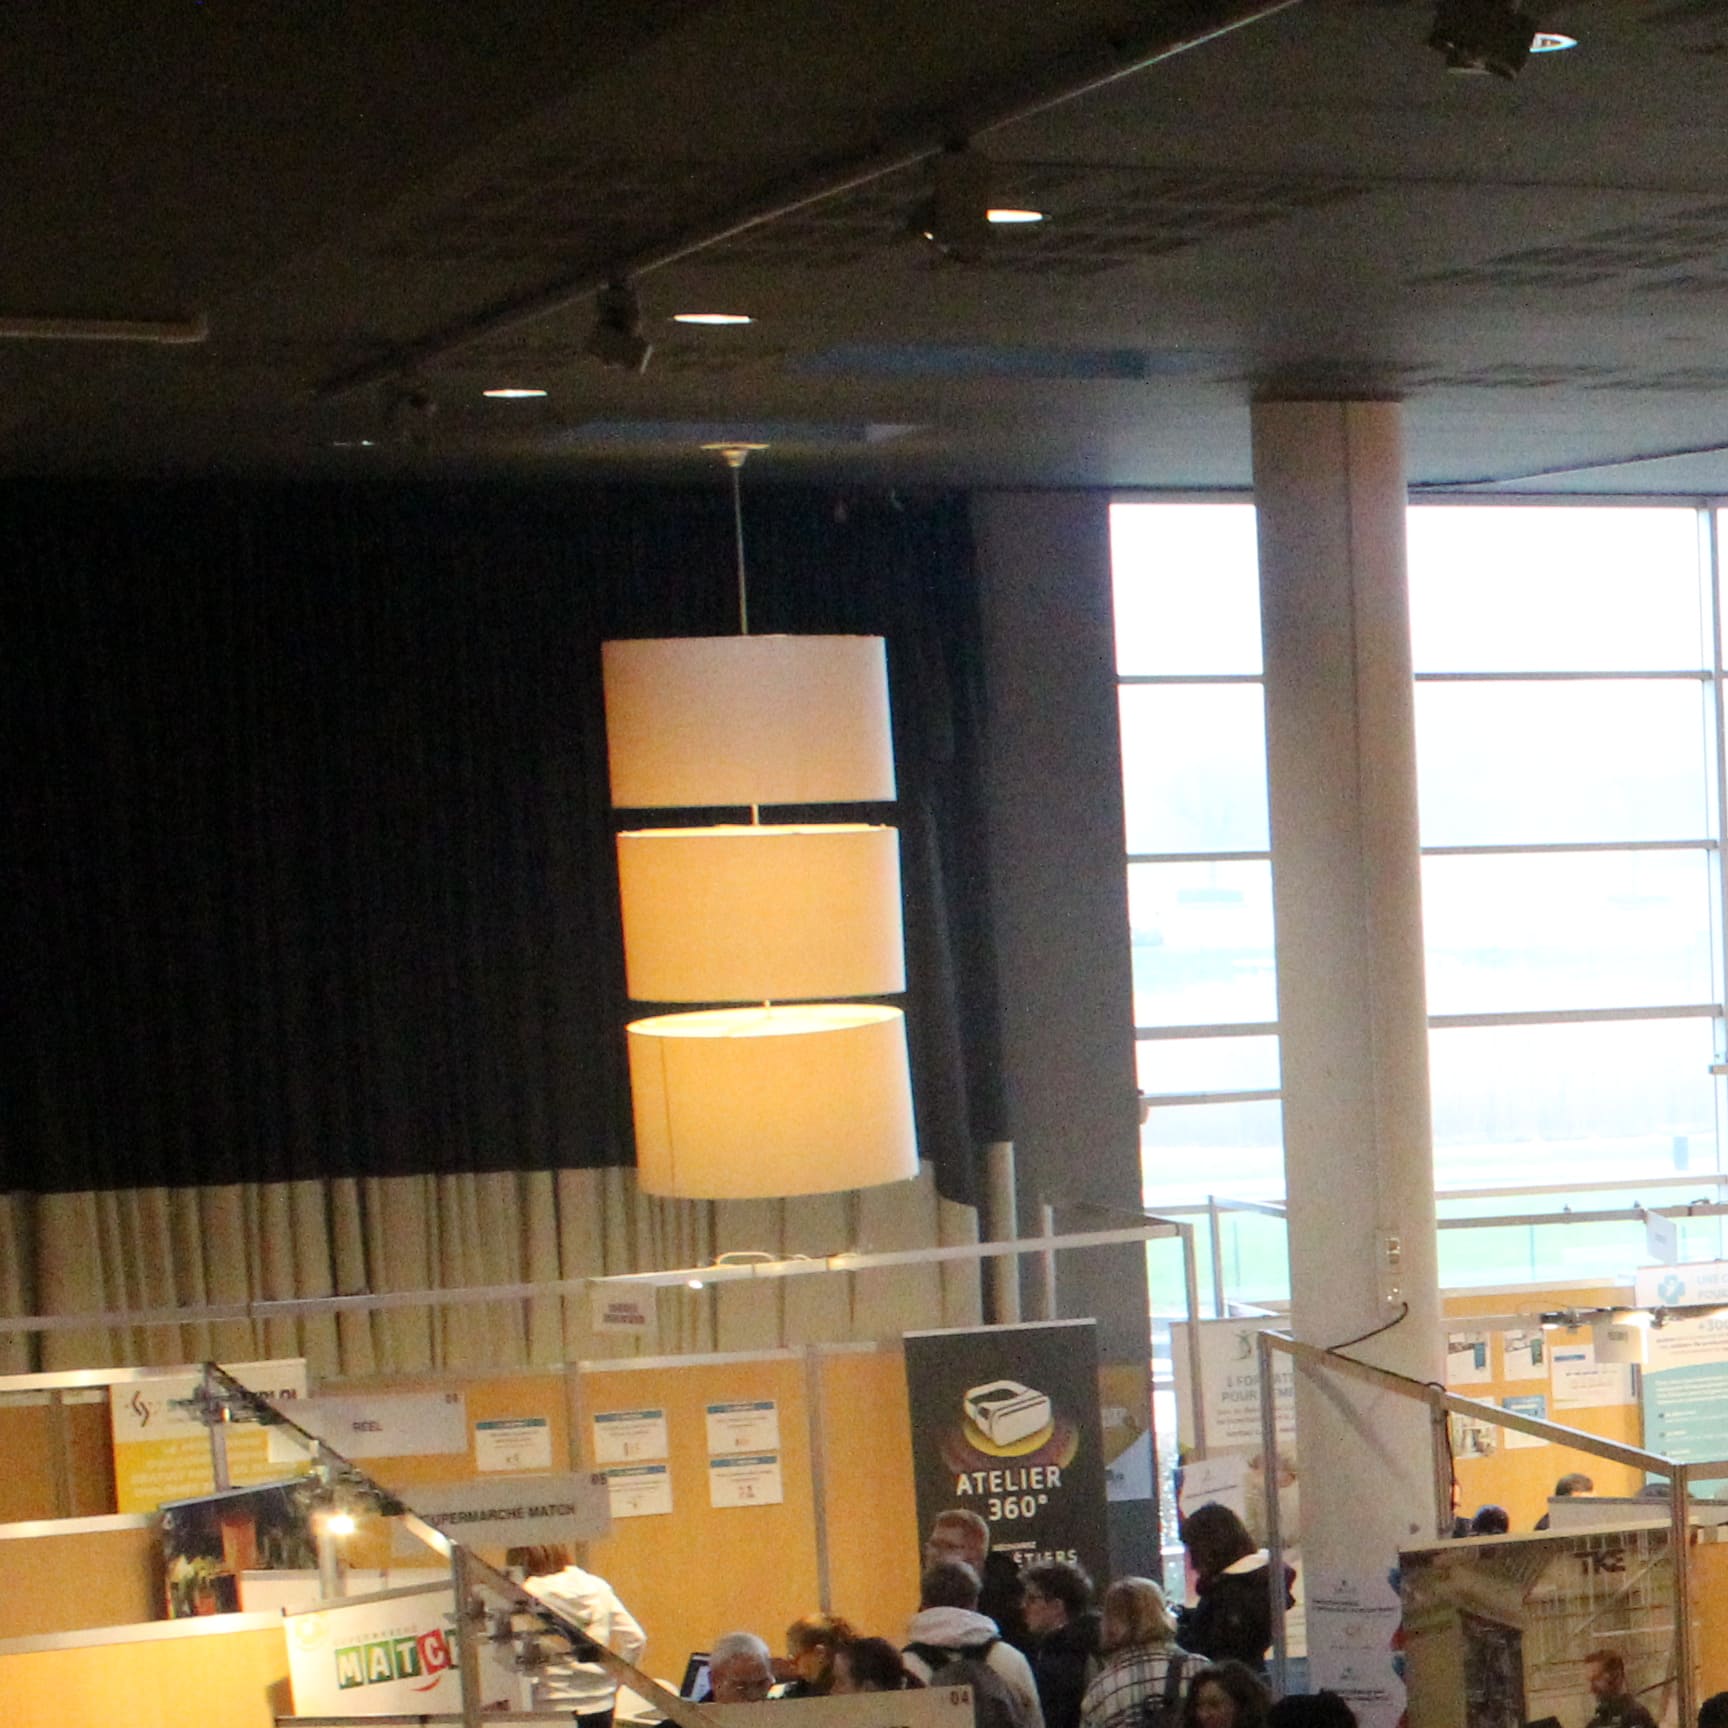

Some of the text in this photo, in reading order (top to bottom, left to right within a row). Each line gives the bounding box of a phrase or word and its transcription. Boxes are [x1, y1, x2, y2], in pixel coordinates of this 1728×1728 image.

[956, 1465, 1062, 1497] ATELIER
[528, 1502, 577, 1521] MATCH
[988, 1495, 1049, 1522] 360°
